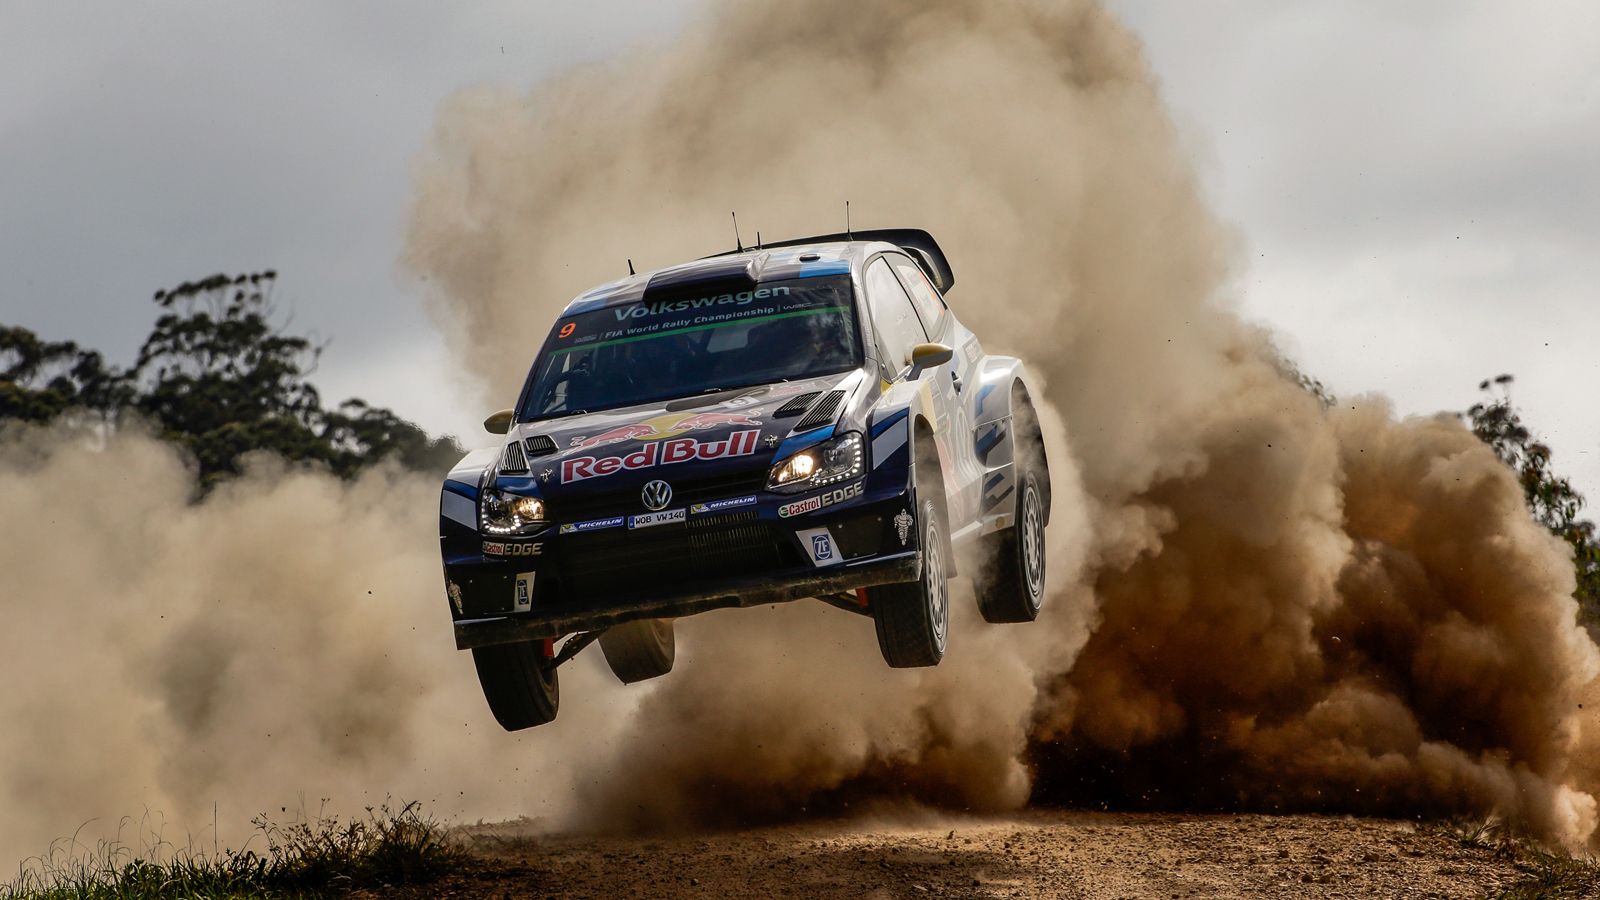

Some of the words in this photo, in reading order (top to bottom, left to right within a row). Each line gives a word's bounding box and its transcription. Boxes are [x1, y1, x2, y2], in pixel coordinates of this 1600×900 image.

[614, 286, 790, 321] Volkswagen
[559, 323, 576, 338] 9
[605, 330, 623, 339] FIA
[626, 323, 659, 334] World
[662, 319, 691, 329] Rally
[694, 307, 774, 323] Championship
[562, 442, 658, 483] Red
[661, 430, 760, 464] Bull
[710, 496, 755, 508] MICHELIN
[788, 498, 819, 515] Castrol
[821, 482, 864, 507] EDGE
[578, 517, 622, 529] MICHELIN
[635, 514, 652, 525] WOB
[504, 542, 544, 556] EDGE
[814, 539, 831, 555] ZF
